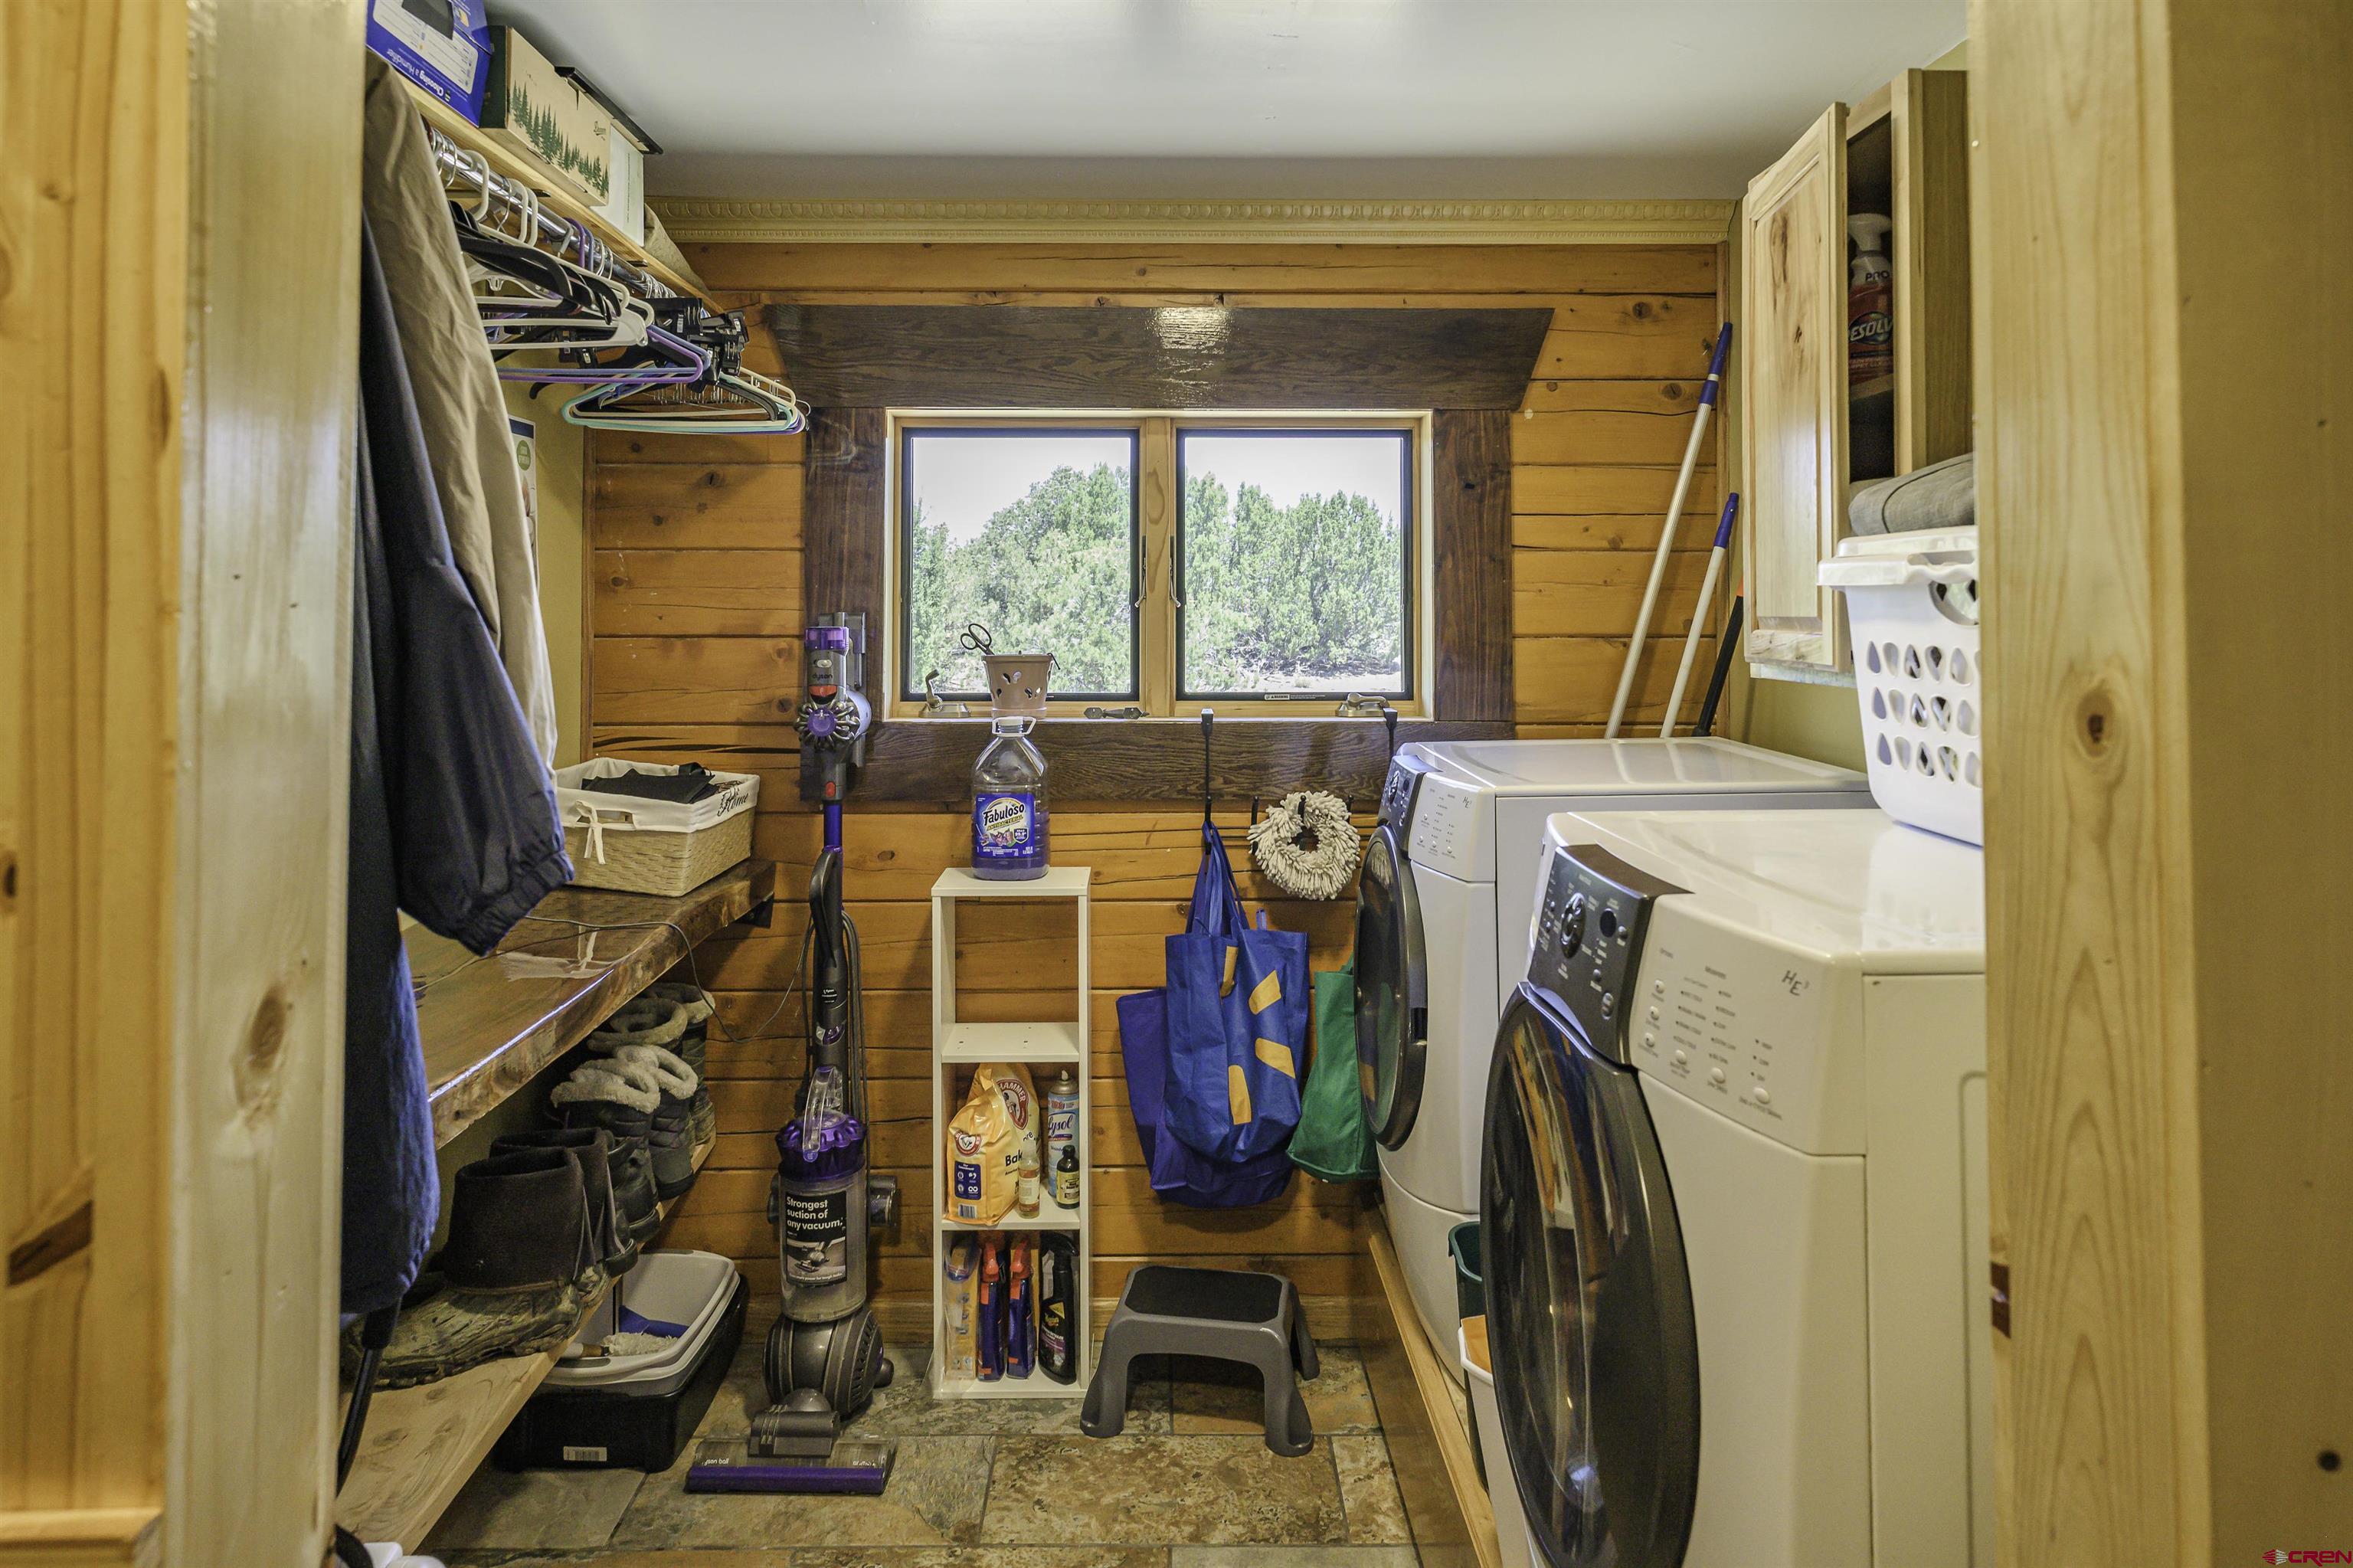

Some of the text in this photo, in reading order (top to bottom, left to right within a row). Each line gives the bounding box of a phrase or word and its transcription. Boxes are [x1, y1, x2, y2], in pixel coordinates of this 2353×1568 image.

[386, 48, 414, 75] Humidifier
[420, 70, 444, 97] Choosing
[1849, 317, 1893, 342] ESOLV
[812, 673, 833, 681] dyson
[983, 804, 1025, 827] Fabuloso
[1006, 1149, 1023, 1167] Bak
[787, 1196, 828, 1210] Strongest
[787, 1209, 828, 1219] suction of
[787, 1219, 800, 1231] any
